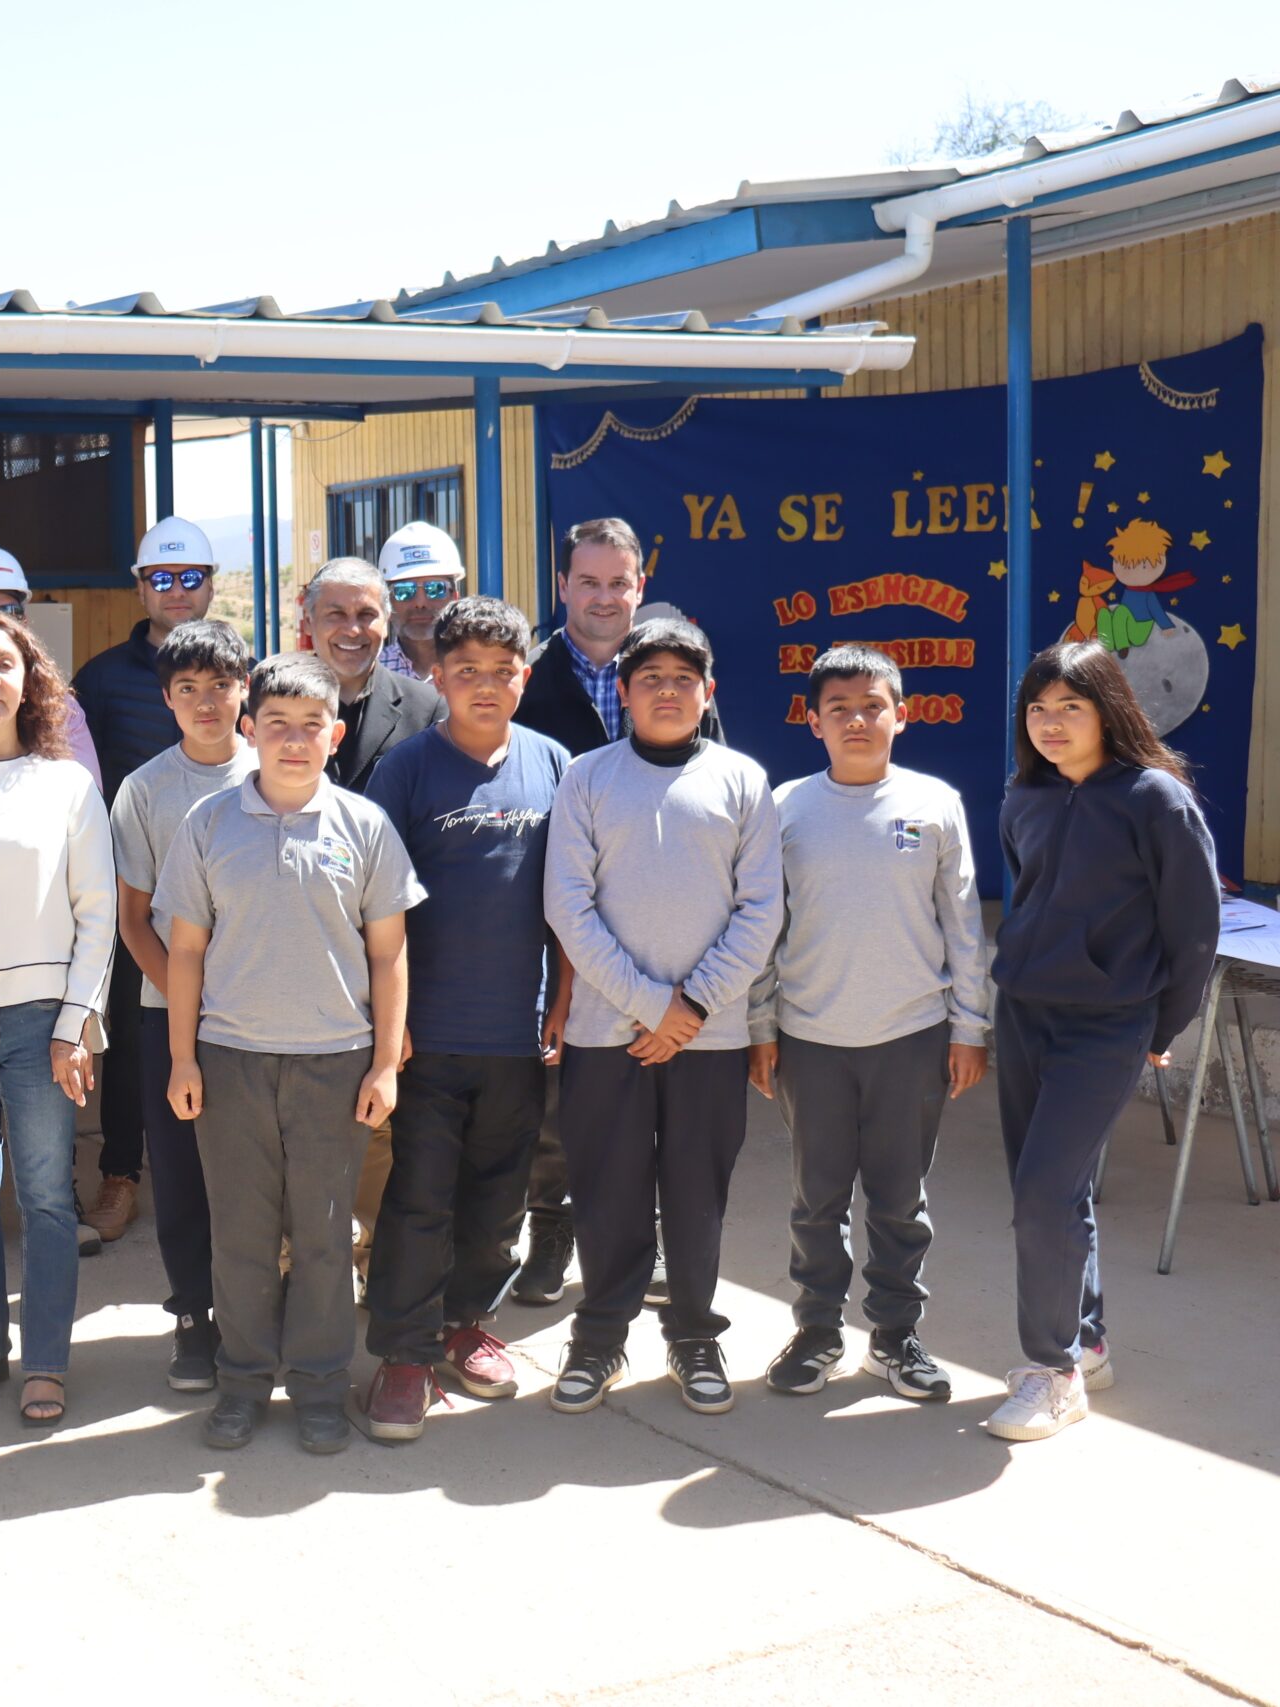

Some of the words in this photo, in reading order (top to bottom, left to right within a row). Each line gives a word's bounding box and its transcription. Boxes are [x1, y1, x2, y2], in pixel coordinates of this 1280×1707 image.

[683, 494, 746, 540] YA
[777, 493, 845, 542] SE
[774, 591, 816, 626] LO
[828, 573, 969, 623] ESENCIAL
[779, 644, 817, 673] ES
[904, 694, 965, 724] JOS
[434, 804, 487, 835] Tommy
